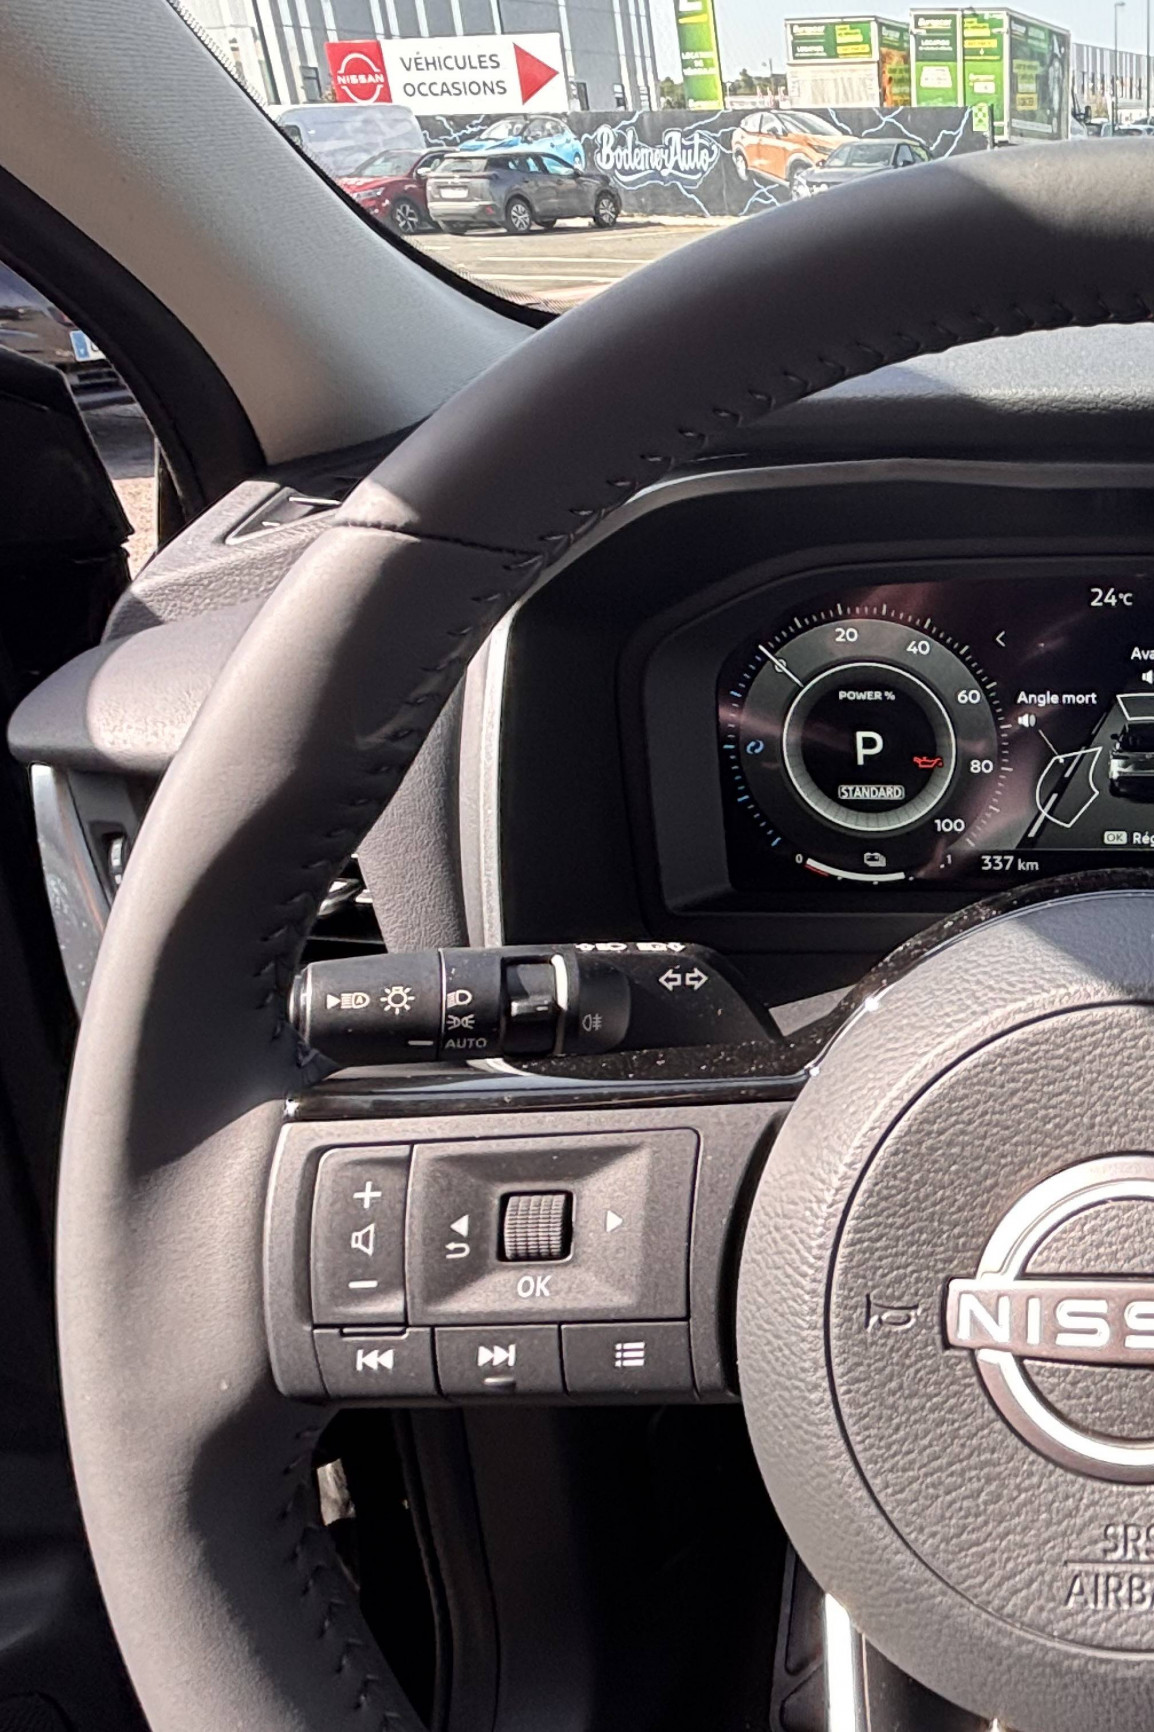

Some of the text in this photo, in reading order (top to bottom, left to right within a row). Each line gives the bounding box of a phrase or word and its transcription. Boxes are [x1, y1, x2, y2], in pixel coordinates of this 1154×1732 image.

[400, 52, 500, 71] VÉHICULES
[337, 74, 384, 85] NISSAN
[403, 80, 507, 97] OCCASIONS
[835, 628, 858, 642] 20
[906, 640, 930, 655] 40
[838, 691, 895, 701] POWER %
[957, 689, 981, 704] 60
[1017, 691, 1097, 706] Angle mort
[855, 731, 884, 765] P
[970, 759, 993, 774] 80
[840, 786, 903, 799] STANDARD
[934, 818, 965, 832] 100
[1106, 833, 1124, 843] OK
[981, 856, 1039, 871] 337 km
[444, 1037, 487, 1050] AUTO
[517, 1275, 552, 1298] OK
